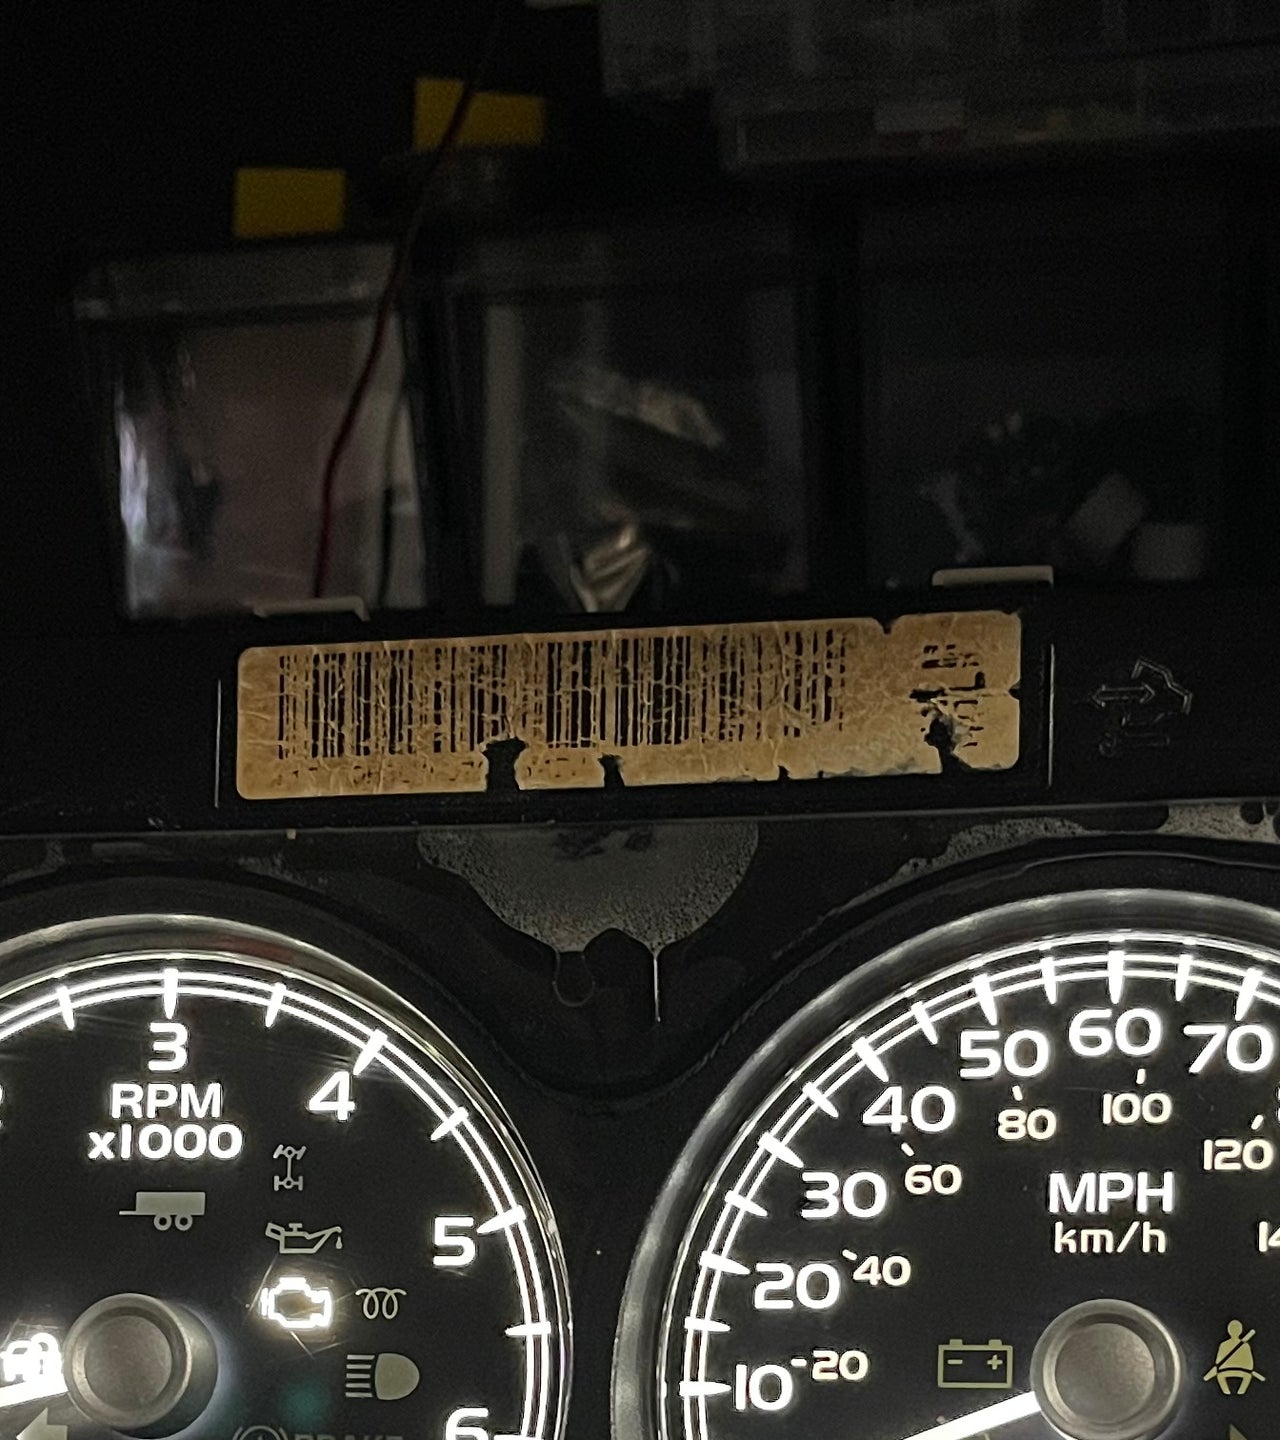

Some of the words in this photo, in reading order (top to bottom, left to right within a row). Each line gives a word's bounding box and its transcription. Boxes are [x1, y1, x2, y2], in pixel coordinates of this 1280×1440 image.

[149, 1023, 187, 1070] 3
[960, 1030, 1048, 1077] 50
[1069, 1009, 1161, 1055] 60
[1184, 1025, 1273, 1072] 70
[112, 1083, 222, 1118] RPM
[309, 1072, 355, 1120] 4
[863, 1086, 955, 1132] 40
[1104, 1094, 1171, 1123] 100
[88, 1124, 242, 1159] x1000
[999, 1109, 1056, 1139] 80
[1204, 1140, 1272, 1169] 120
[802, 1172, 886, 1217] 30
[905, 1165, 961, 1194] 60
[1050, 1171, 1173, 1213] MPH
[434, 1218, 475, 1265] 5
[1055, 1222, 1165, 1253] km/h
[755, 1263, 840, 1308] 20
[854, 1256, 910, 1285] 40
[813, 1351, 867, 1379] 20
[736, 1365, 792, 1410] 10
